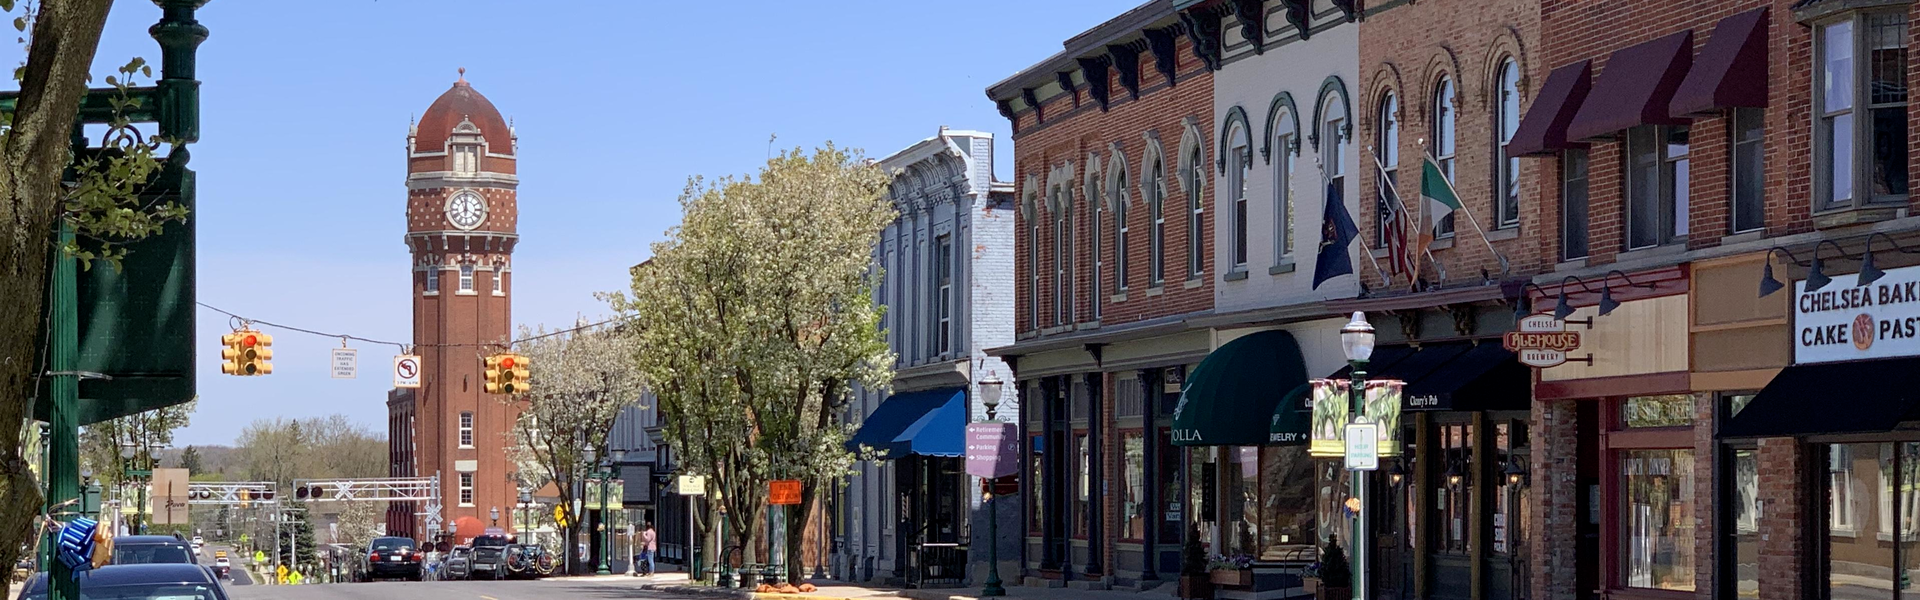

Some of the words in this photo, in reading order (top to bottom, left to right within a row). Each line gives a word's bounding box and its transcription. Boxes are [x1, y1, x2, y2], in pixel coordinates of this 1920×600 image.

[1800, 286, 1873, 314] CHELSEA
[1878, 280, 1920, 306] BAK
[1528, 320, 1558, 328] CHELSEA
[1801, 323, 1848, 347] CAKE
[1526, 353, 1559, 361] BREWERY
[1429, 395, 1438, 406] Pub
[1172, 428, 1202, 441] OLLA
